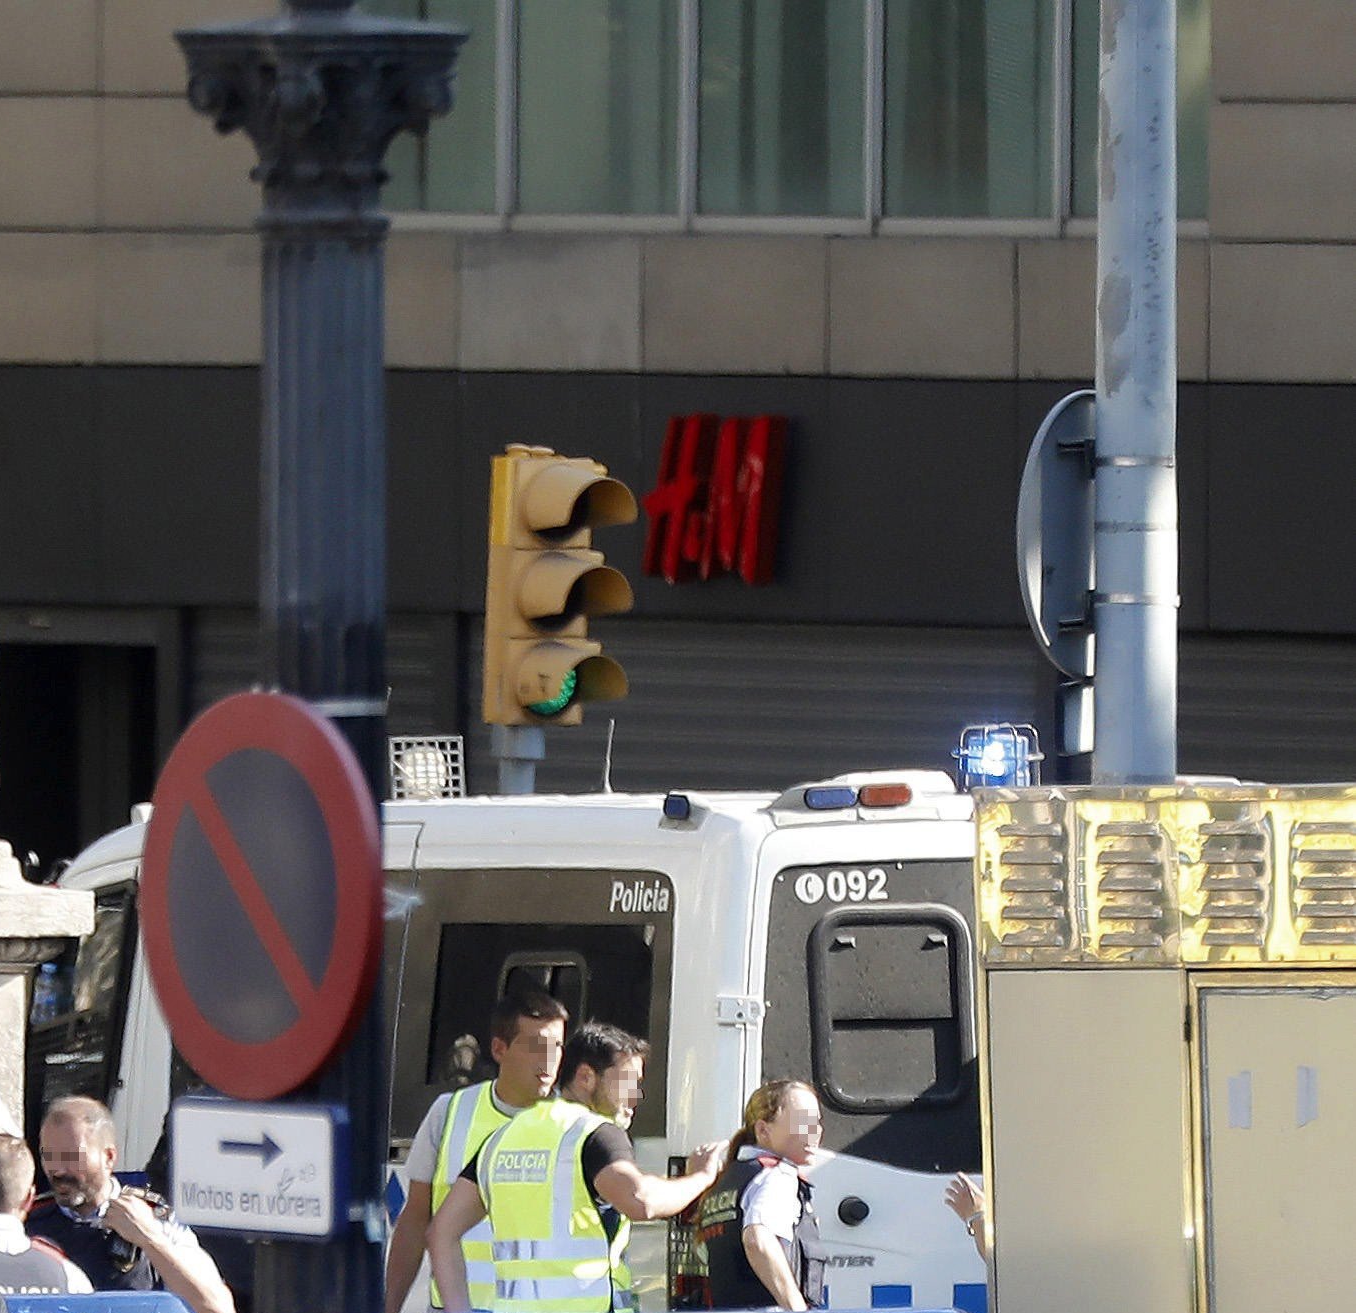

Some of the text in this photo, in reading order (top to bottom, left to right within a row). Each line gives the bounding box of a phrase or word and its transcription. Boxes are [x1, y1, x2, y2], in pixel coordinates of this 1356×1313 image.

[610, 881, 669, 913] Policia
[827, 868, 889, 901] 092
[497, 1153, 547, 1169] POLICIA
[181, 1182, 234, 1212] Motos
[240, 1192, 261, 1214] en
